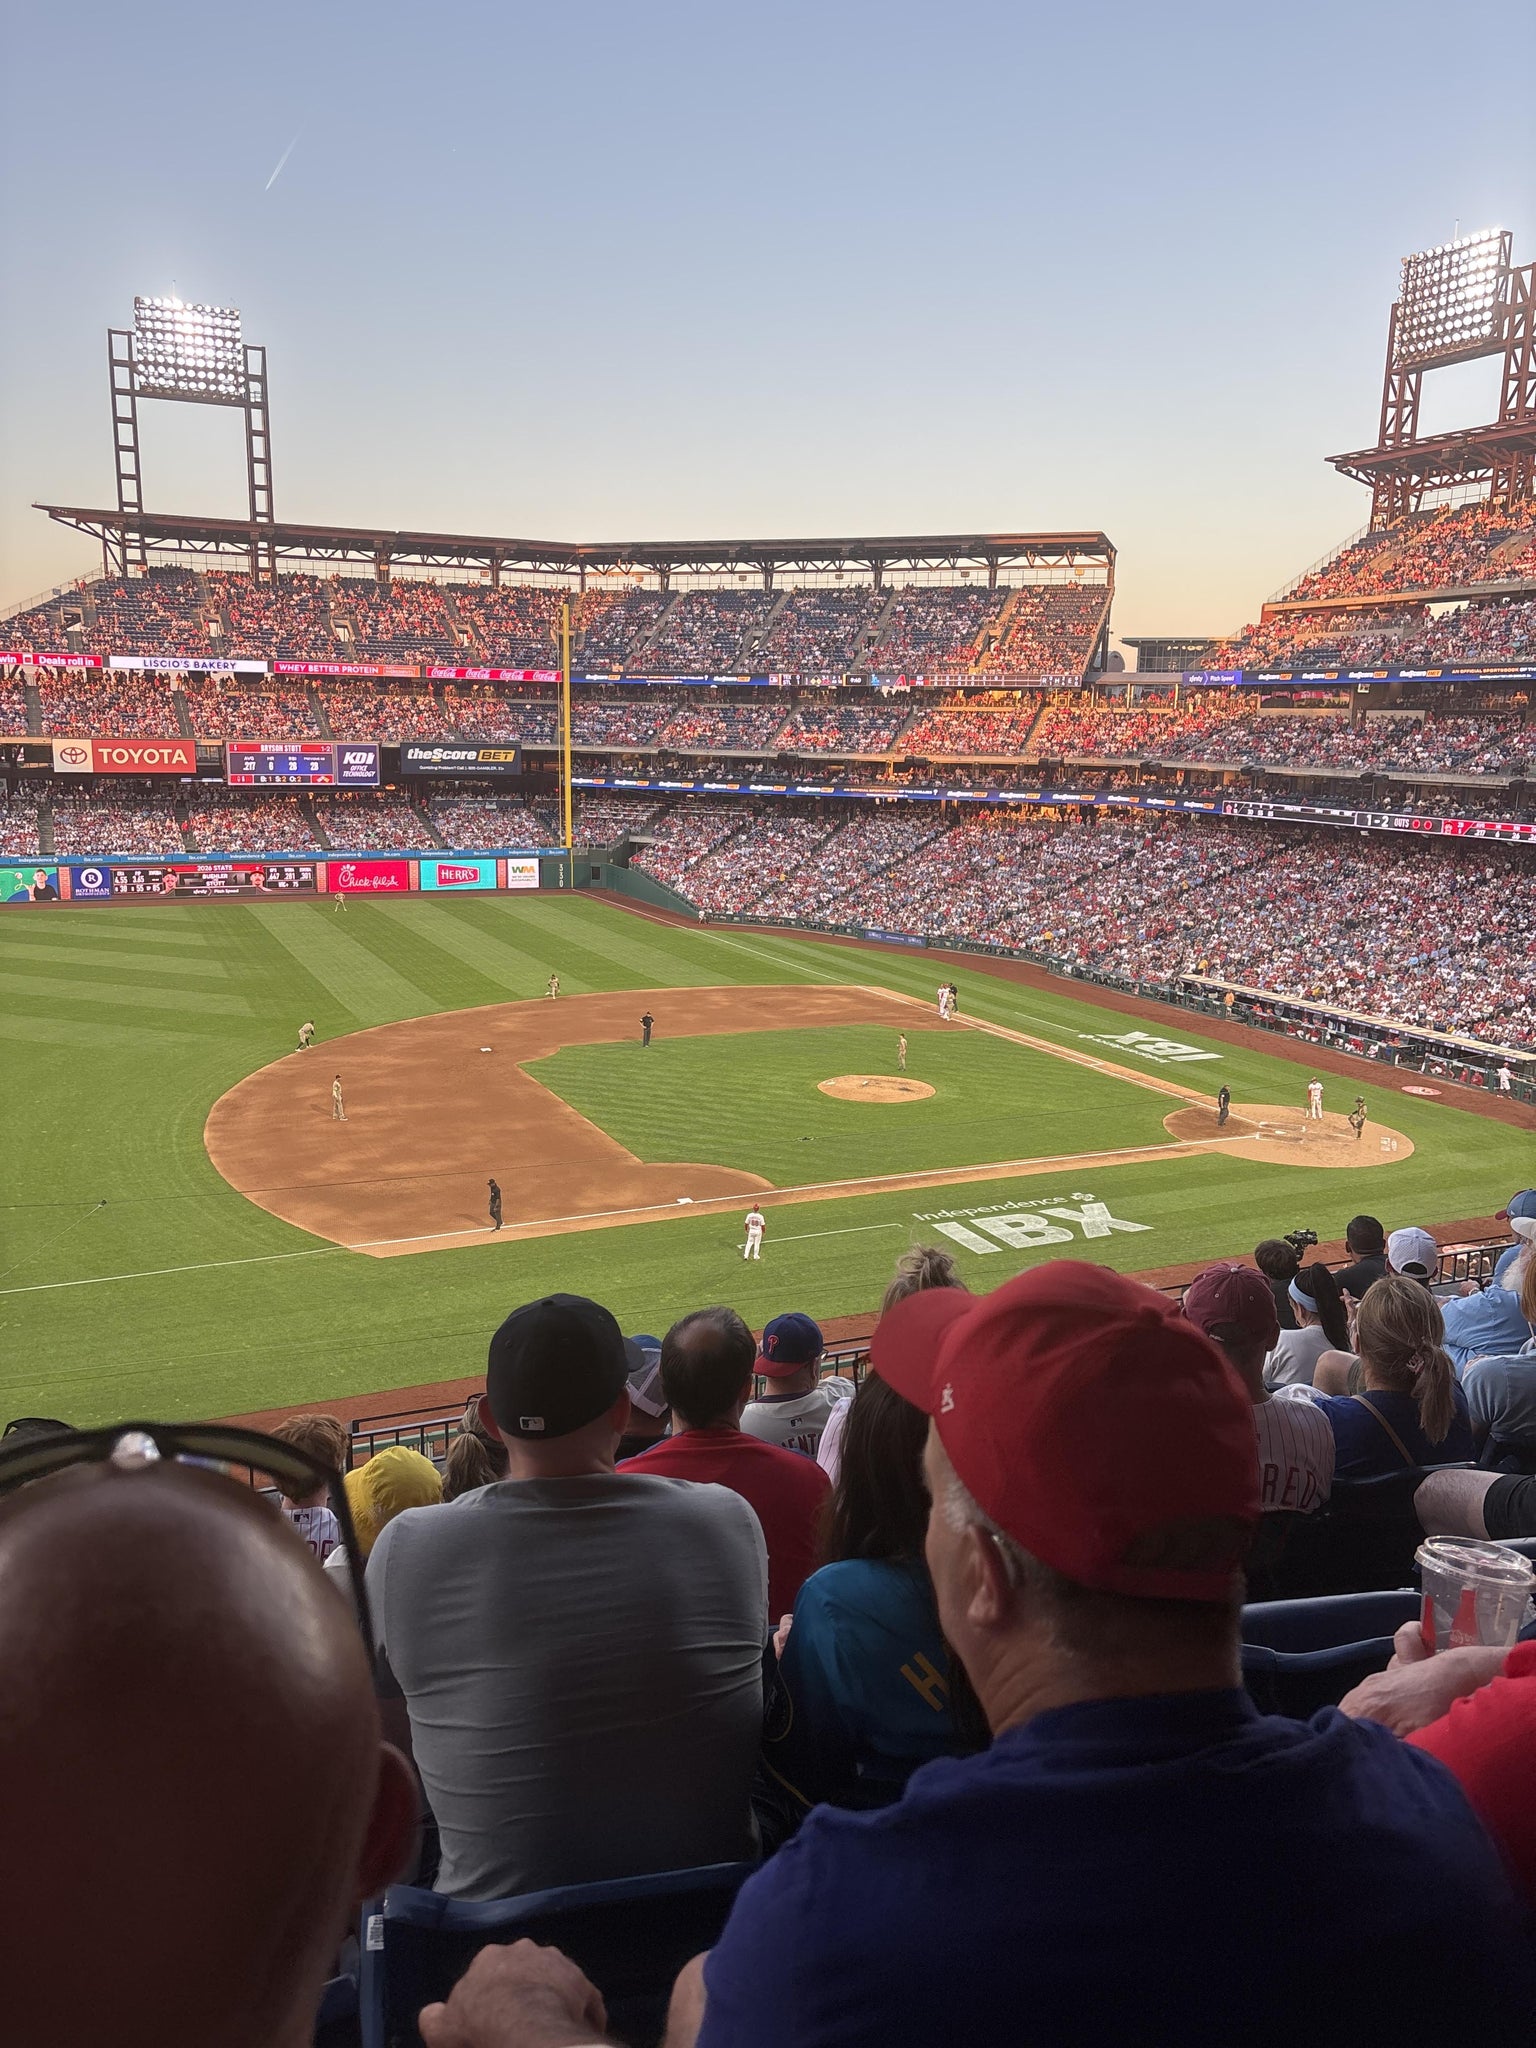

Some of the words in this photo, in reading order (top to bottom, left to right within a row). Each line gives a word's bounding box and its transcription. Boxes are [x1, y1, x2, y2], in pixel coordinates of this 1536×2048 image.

[39, 656, 64, 665] Deals
[68, 657, 84, 666] roll
[84, 657, 95, 666] in
[143, 659, 190, 670] LISCIO'S
[193, 660, 236, 670] BAKERY
[279, 663, 306, 672] WHEY
[308, 664, 341, 673] BETTER
[341, 665, 379, 674] PROTEIN
[260, 744, 283, 752] BRYSON
[284, 744, 302, 752] STOTT
[98, 748, 188, 765] TOYOTA
[407, 748, 478, 760] theScore
[481, 751, 513, 760] BET
[342, 770, 376, 778] TECHNOLOGY
[1393, 817, 1410, 828] OUTS
[441, 869, 475, 881] HERR'S
[512, 866, 535, 874] WM
[88, 874, 97, 882] R
[338, 867, 400, 889] Chick-fil-A
[912, 1195, 1069, 1222] Independence
[930, 1202, 1155, 1255] IBX
[768, 1334, 780, 1354] P
